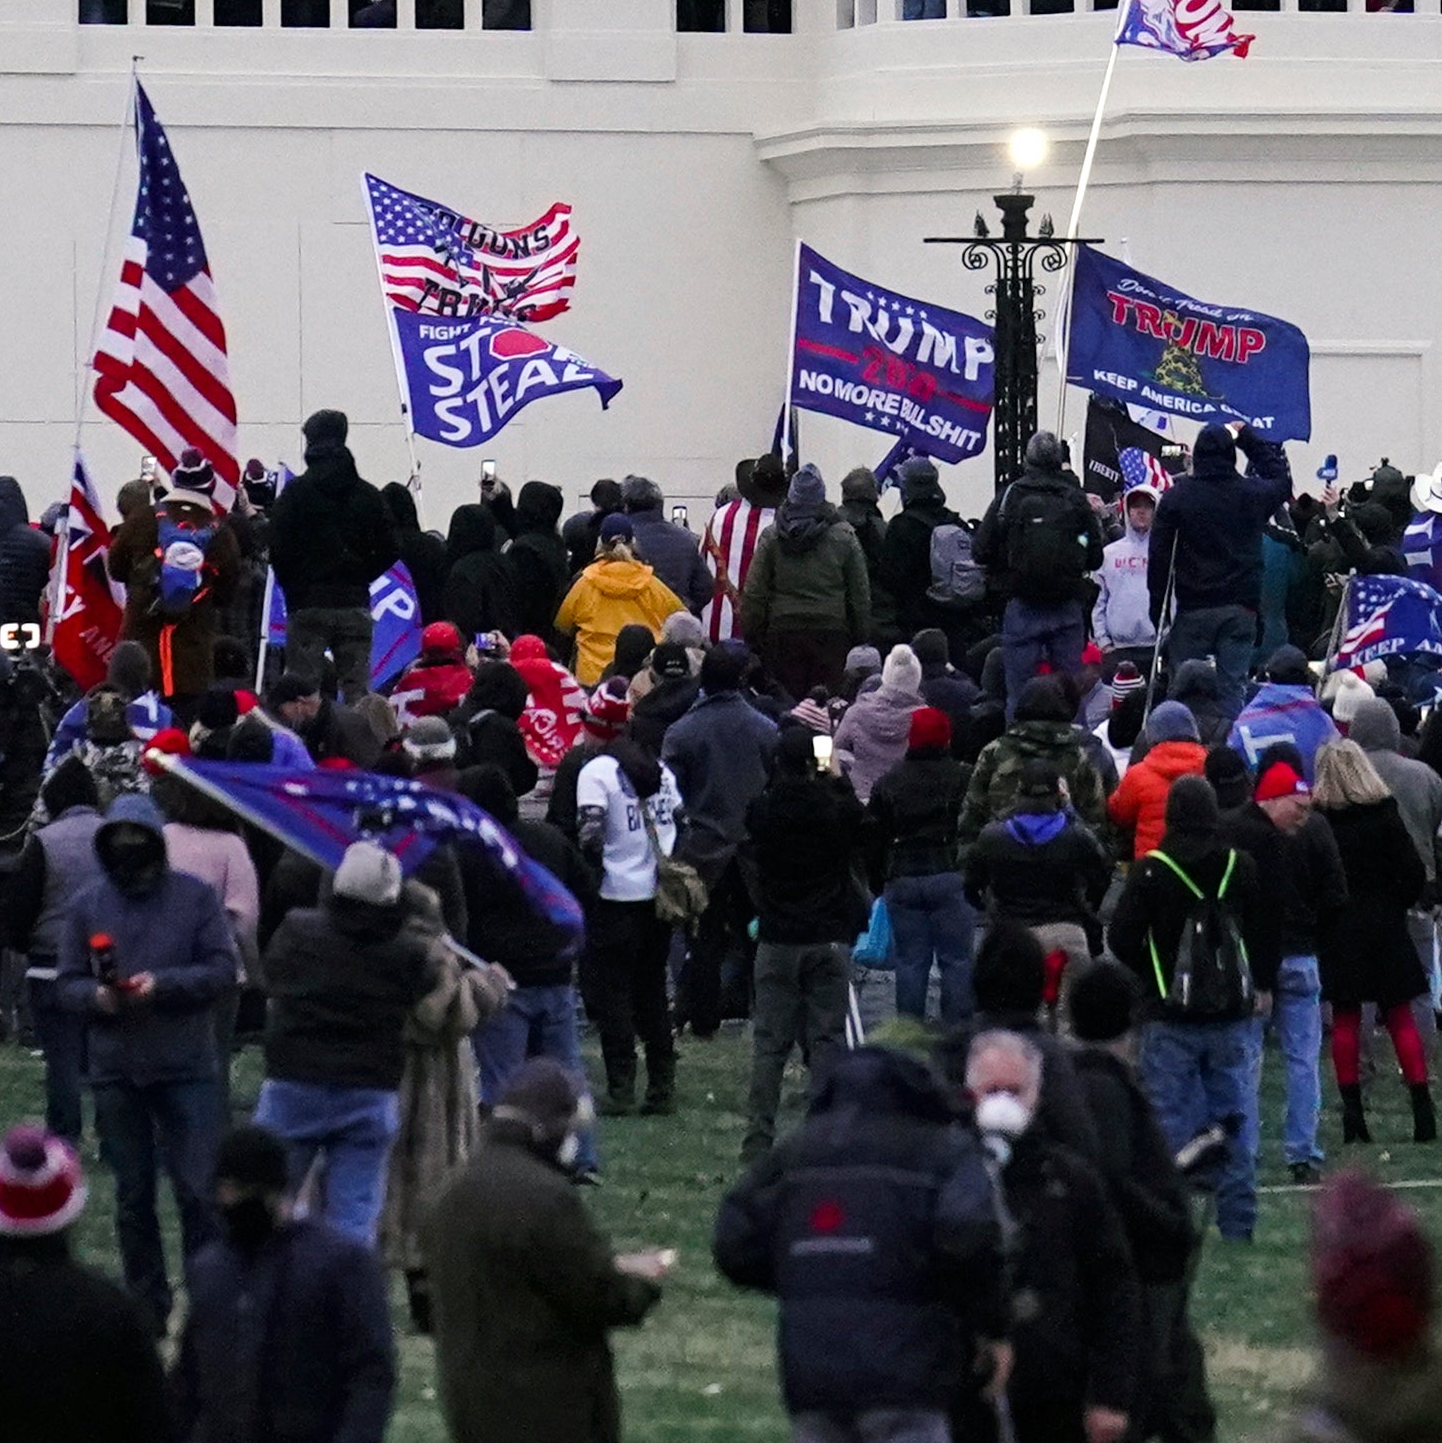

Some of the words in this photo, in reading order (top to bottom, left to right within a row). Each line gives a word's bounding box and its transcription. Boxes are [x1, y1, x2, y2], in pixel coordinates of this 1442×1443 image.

[467, 222, 551, 258] GUNS
[419, 322, 471, 340] FIGHT
[809, 269, 995, 381] TRUMP
[1107, 290, 1267, 365] TRUMP
[434, 353, 595, 442] STEAL
[799, 369, 834, 392] NO
[834, 378, 904, 415] MORE
[1093, 369, 1139, 392] KEEP
[1141, 385, 1217, 414] AMERICA
[1351, 636, 1405, 663] KEEP
